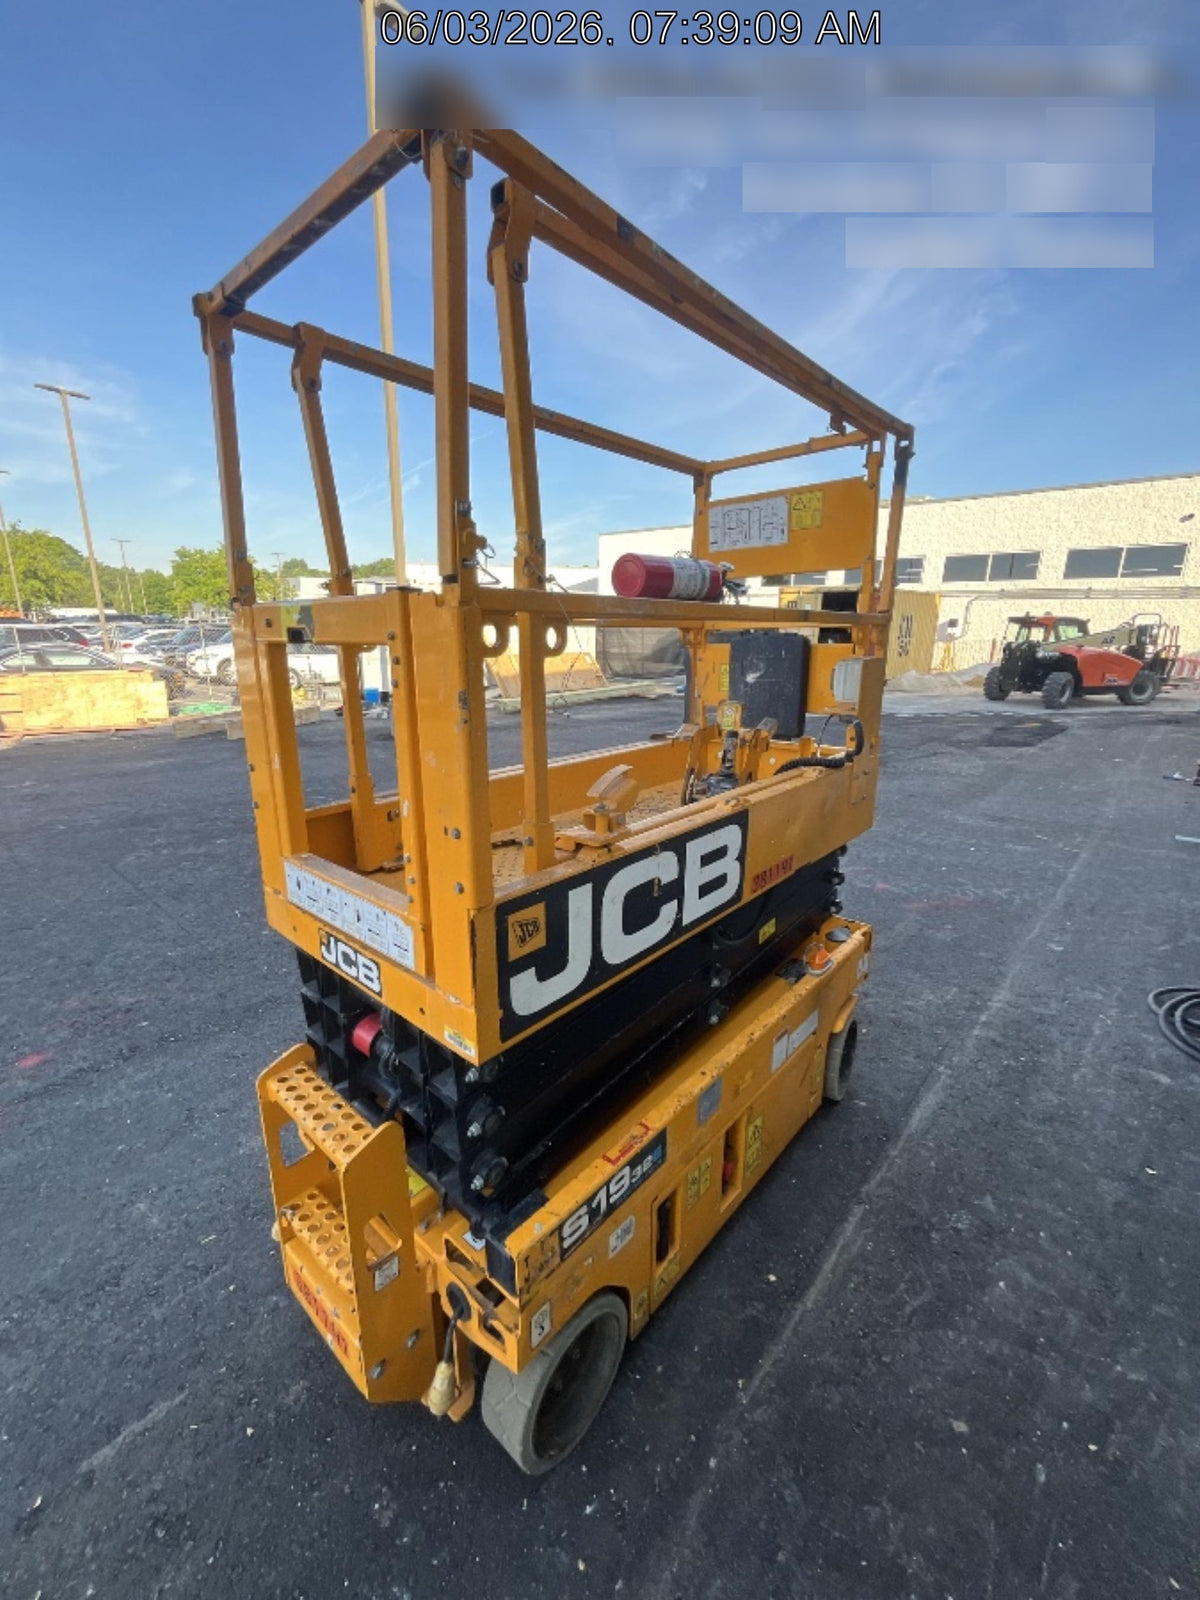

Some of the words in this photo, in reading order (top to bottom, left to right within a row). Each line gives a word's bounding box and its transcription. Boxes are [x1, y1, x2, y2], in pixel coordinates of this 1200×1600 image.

[510, 824, 742, 1016] JCB
[516, 918, 541, 947] JCB
[321, 936, 382, 993] JCB
